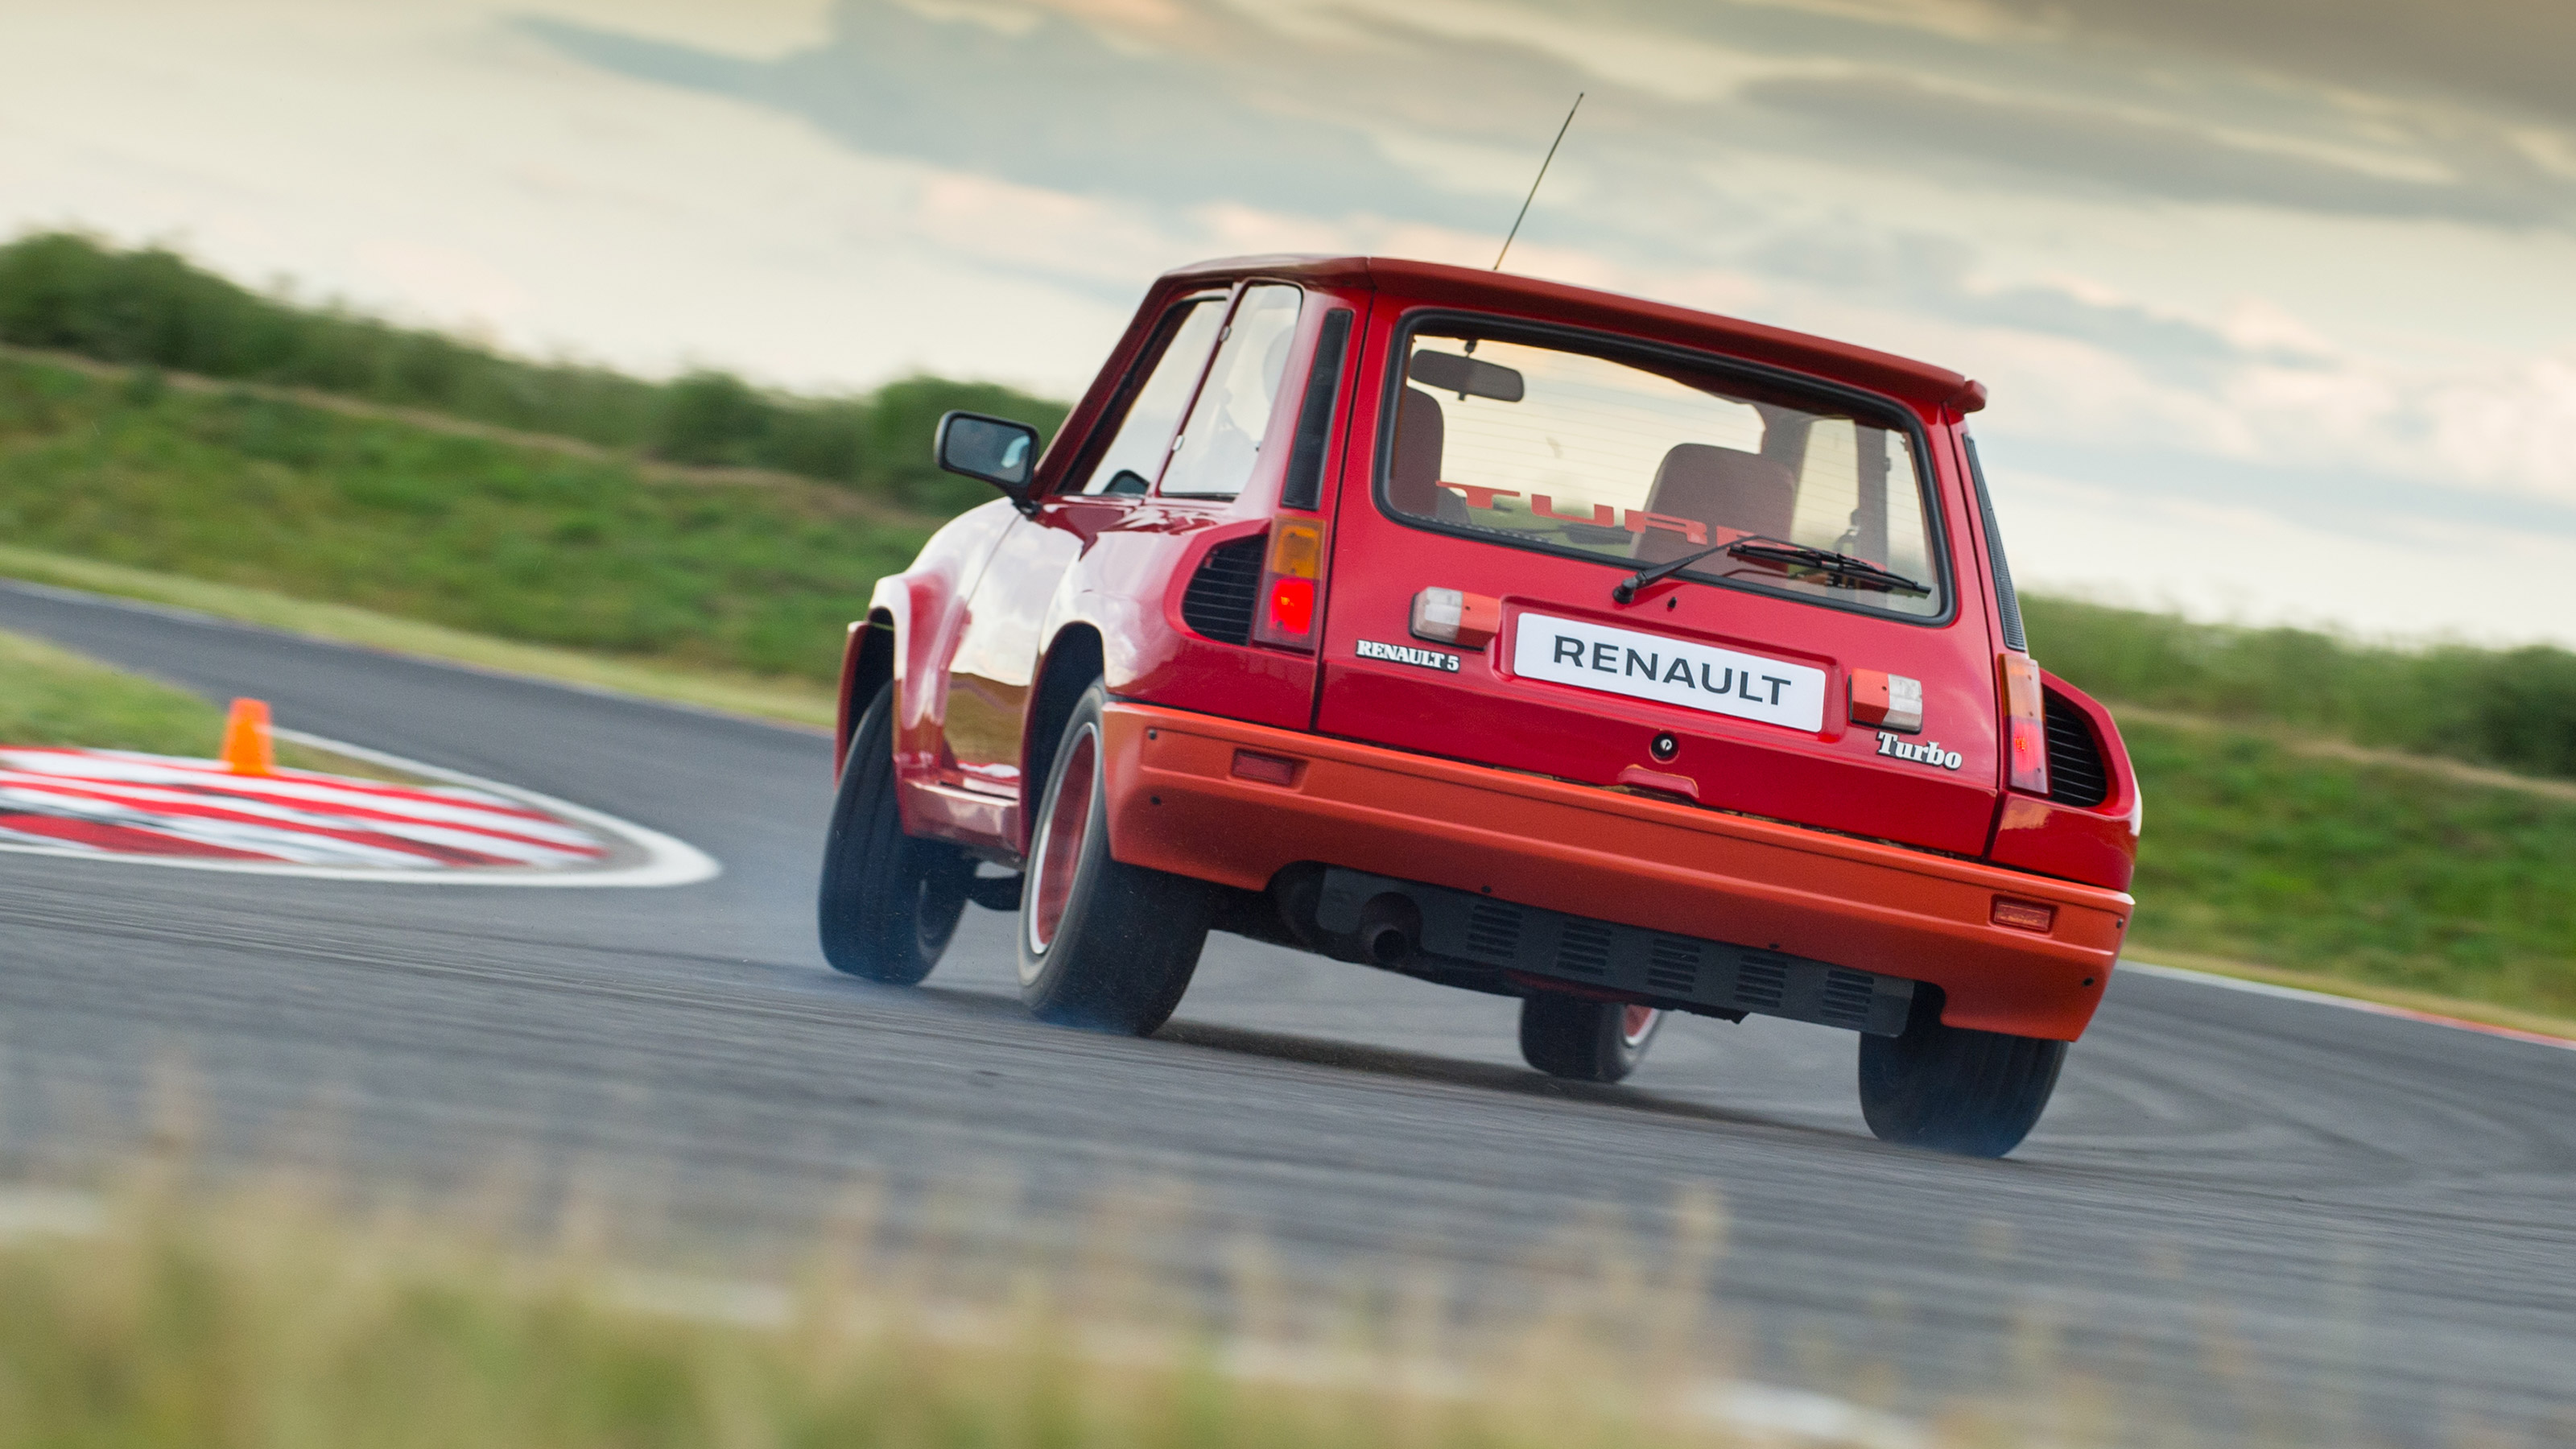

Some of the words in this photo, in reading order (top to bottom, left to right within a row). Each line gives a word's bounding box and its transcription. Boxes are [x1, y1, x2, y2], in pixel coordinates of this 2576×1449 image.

[1356, 639, 1445, 668] RENAULT
[1447, 654, 1459, 671] 5
[1554, 634, 1792, 706] RENAULT
[1877, 731, 1963, 769] Turbo
